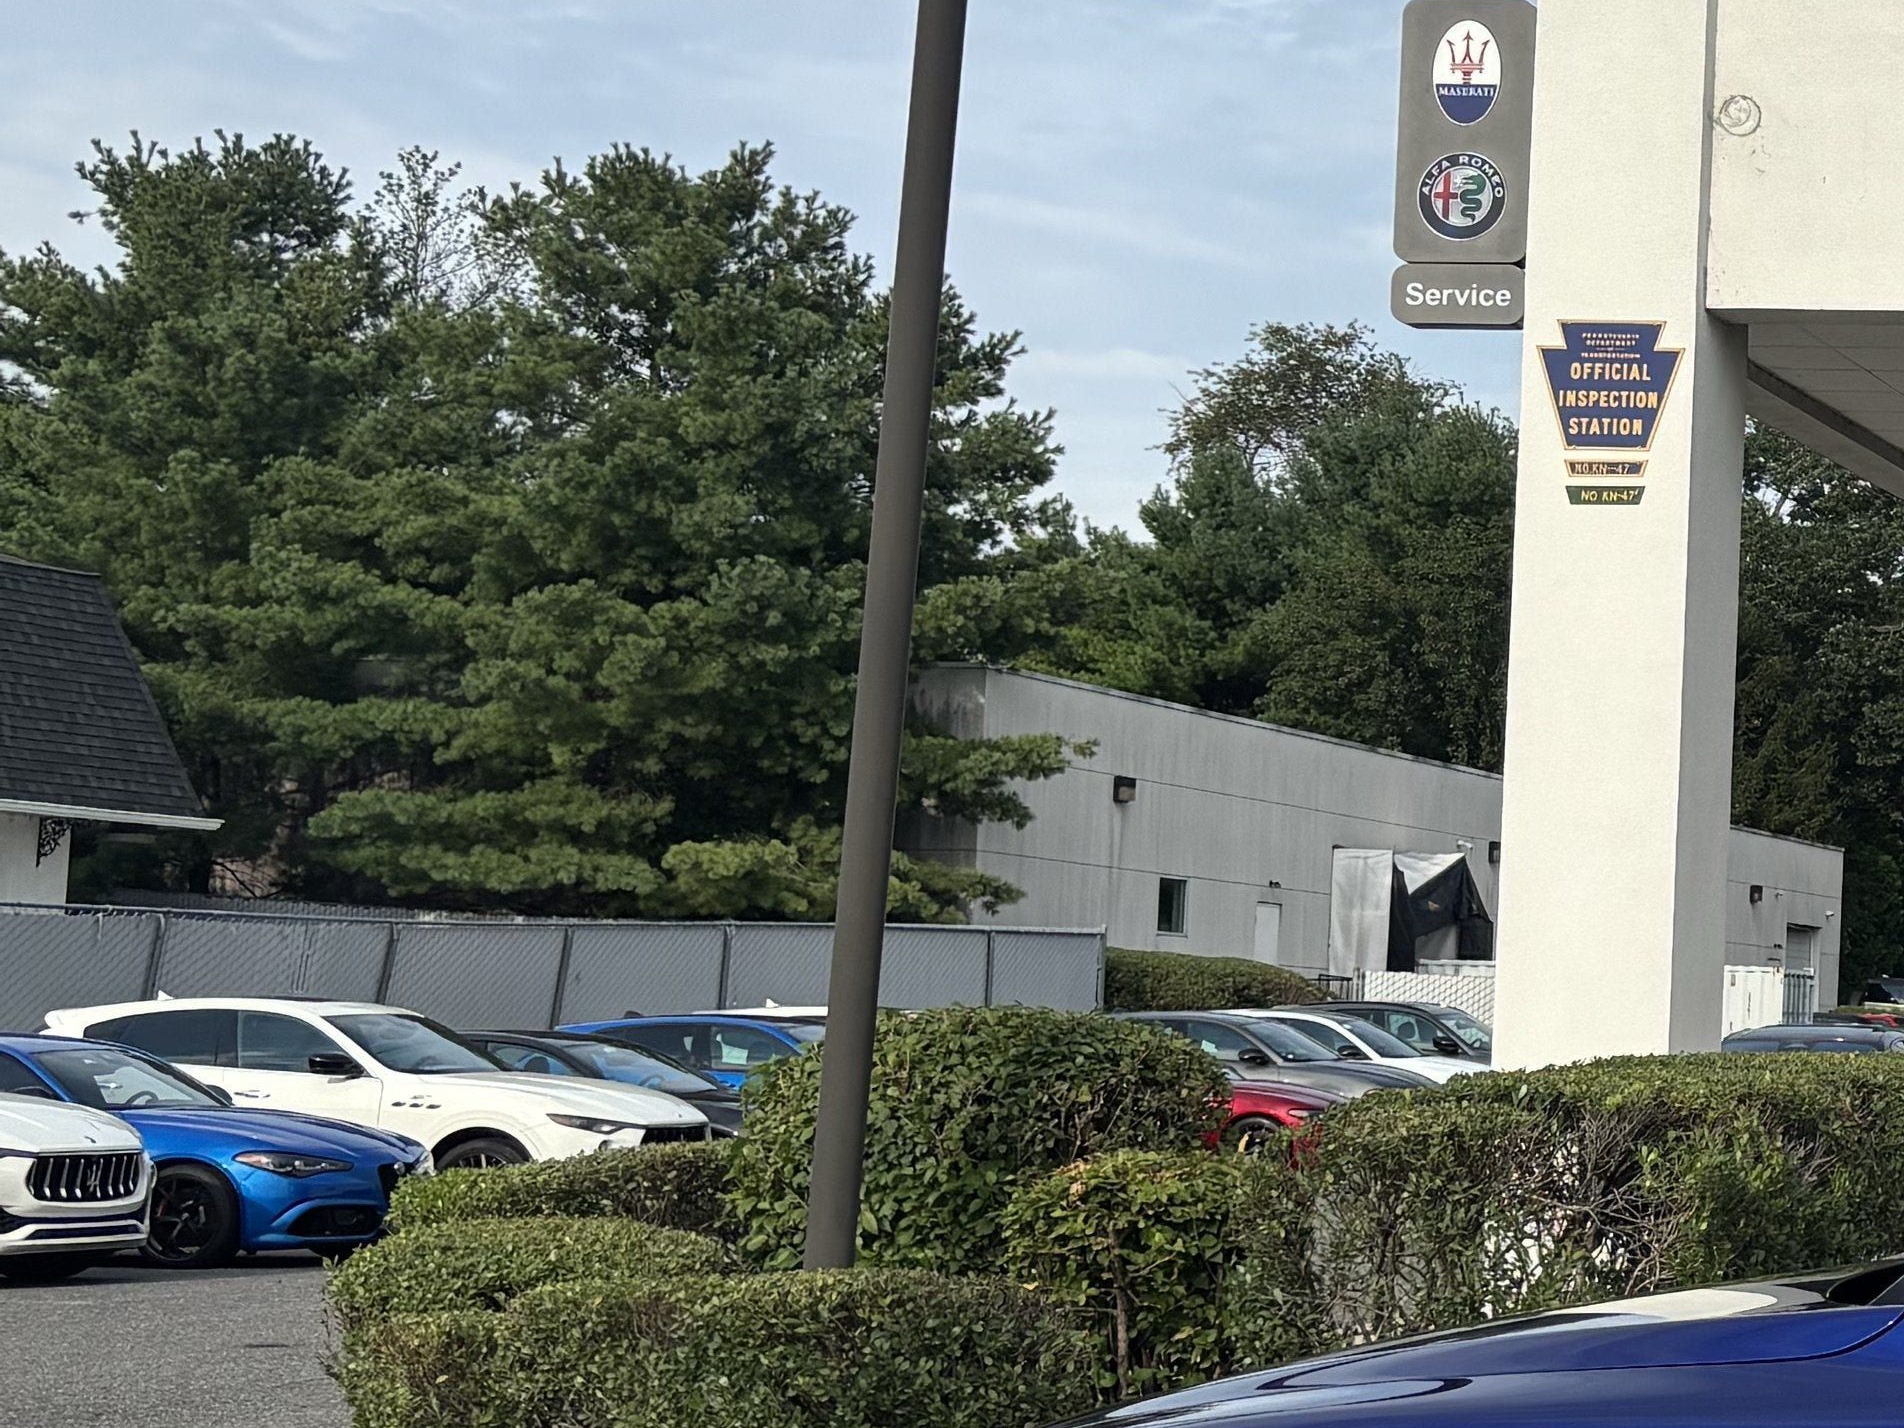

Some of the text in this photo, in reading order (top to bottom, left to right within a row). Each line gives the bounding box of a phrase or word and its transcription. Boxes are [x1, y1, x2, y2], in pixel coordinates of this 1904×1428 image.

[1438, 86, 1494, 96] MASERATI
[1421, 155, 1504, 198] ALFA ROMEO
[1405, 282, 1512, 307] Service
[1570, 362, 1651, 381] OFFICIAL
[1559, 390, 1658, 409] INSPECTION
[1568, 418, 1643, 436] STATION
